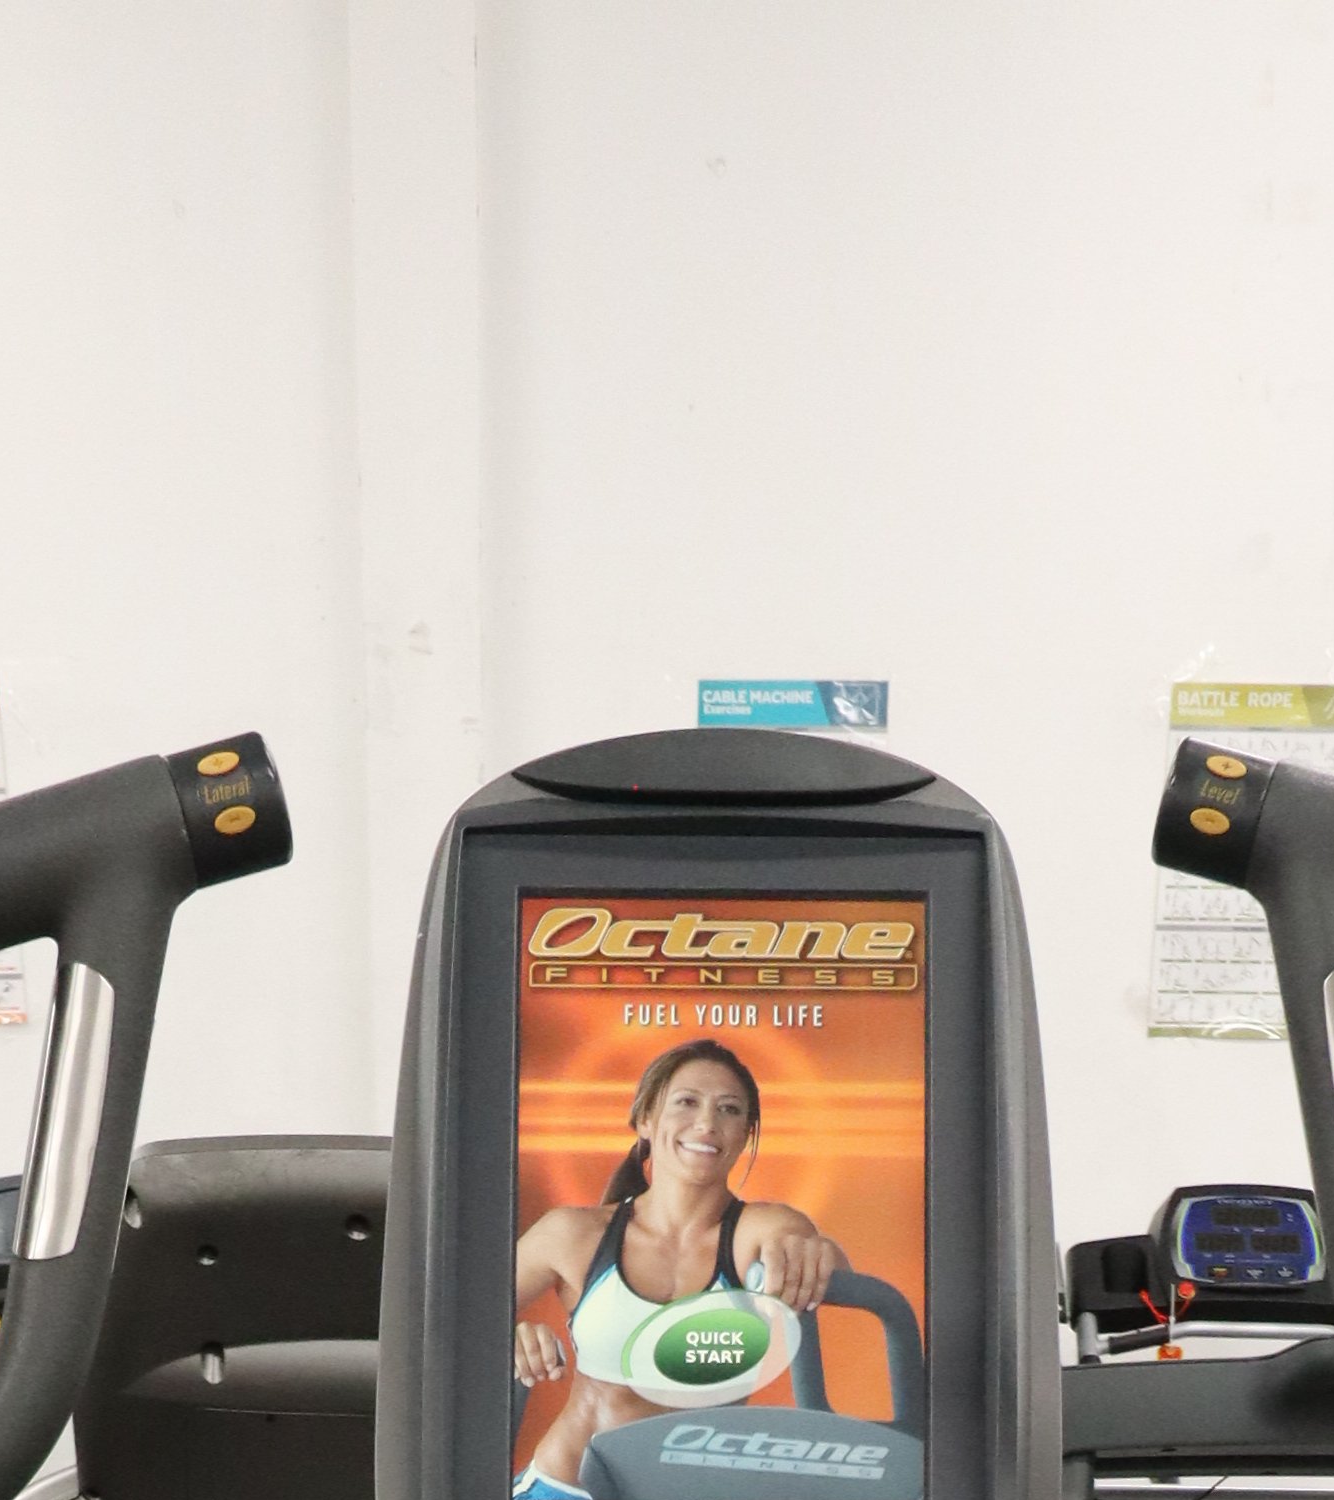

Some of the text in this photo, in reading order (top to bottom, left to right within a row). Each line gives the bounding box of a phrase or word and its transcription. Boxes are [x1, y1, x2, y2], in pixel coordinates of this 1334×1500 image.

[702, 688, 815, 704] CABLE MACHINE
[1177, 690, 1294, 709] BATTLE ROPE
[203, 774, 252, 805] Lateral
[1199, 779, 1243, 805] Level
[528, 907, 913, 960] Octane
[545, 967, 896, 985] FITNESS
[622, 1003, 825, 1028] FUEL YOUR LIFE
[685, 1331, 745, 1346] QUICK
[685, 1349, 745, 1365] START
[662, 1424, 890, 1465] Octane
